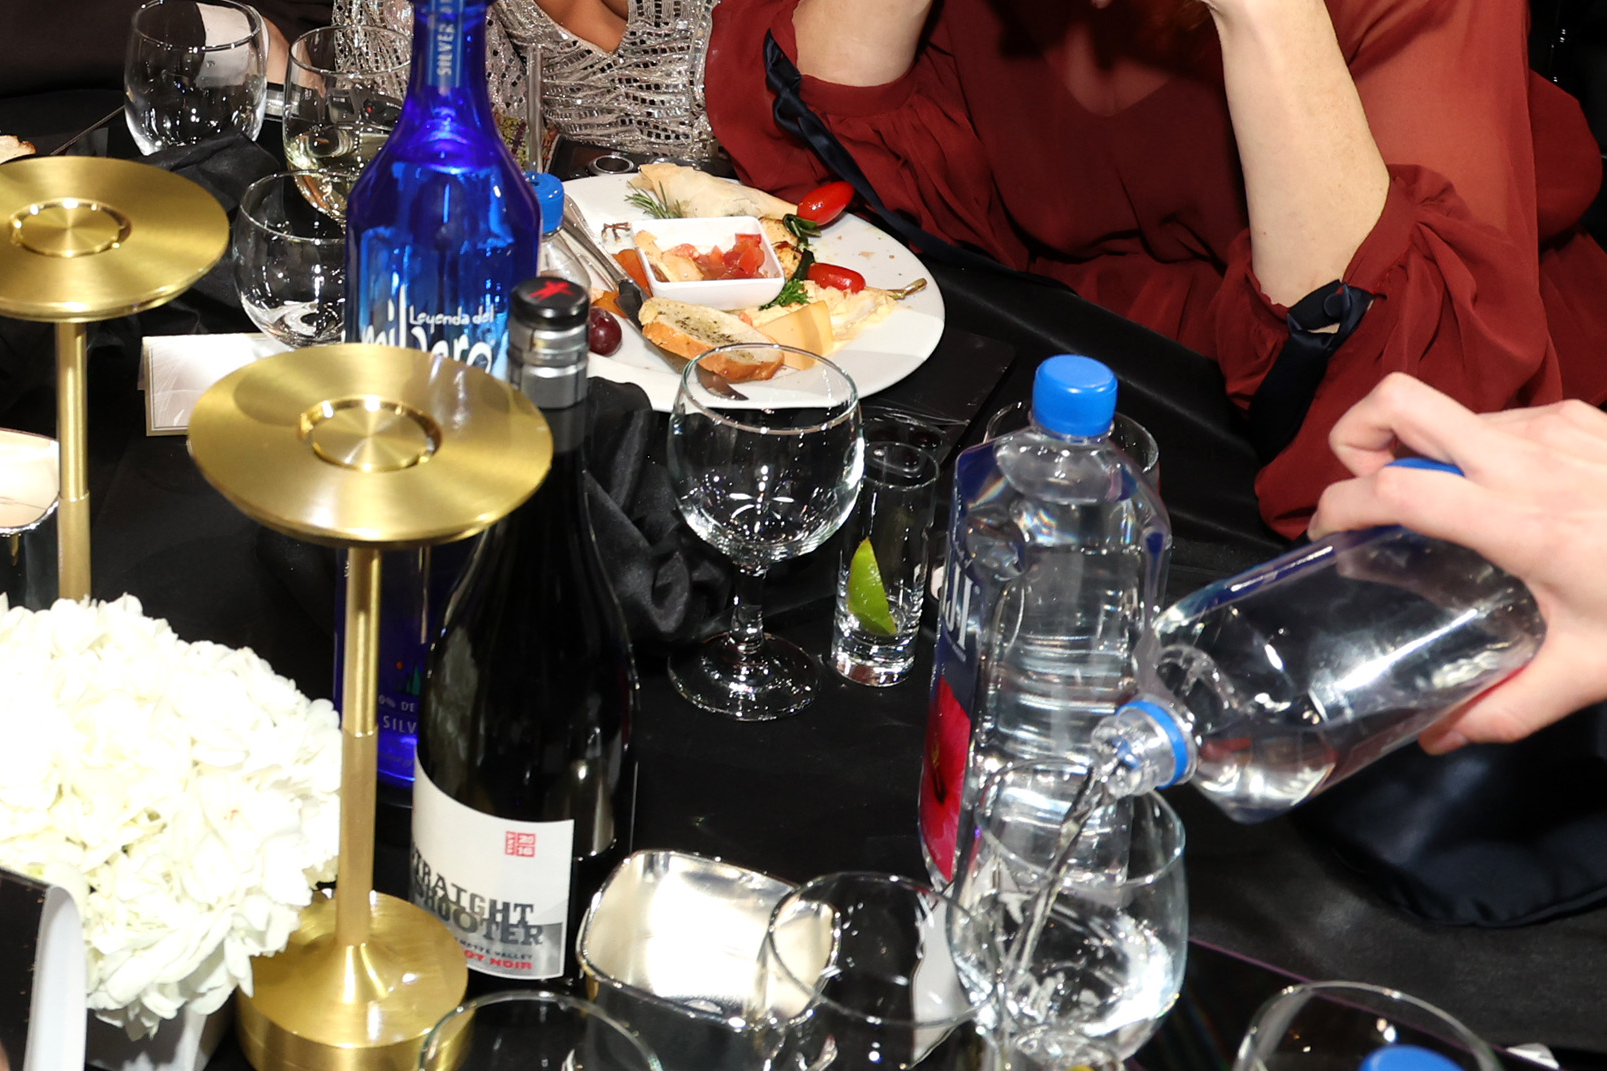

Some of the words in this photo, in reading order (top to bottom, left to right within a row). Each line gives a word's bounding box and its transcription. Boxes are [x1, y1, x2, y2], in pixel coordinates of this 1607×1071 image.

[409, 305, 470, 334] Leyenda
[472, 303, 494, 325] del
[944, 561, 974, 651] JI
[401, 701, 416, 712] DE
[383, 715, 417, 734] SILV
[411, 846, 535, 927] TRAIGHT
[489, 957, 533, 970] NOIR
